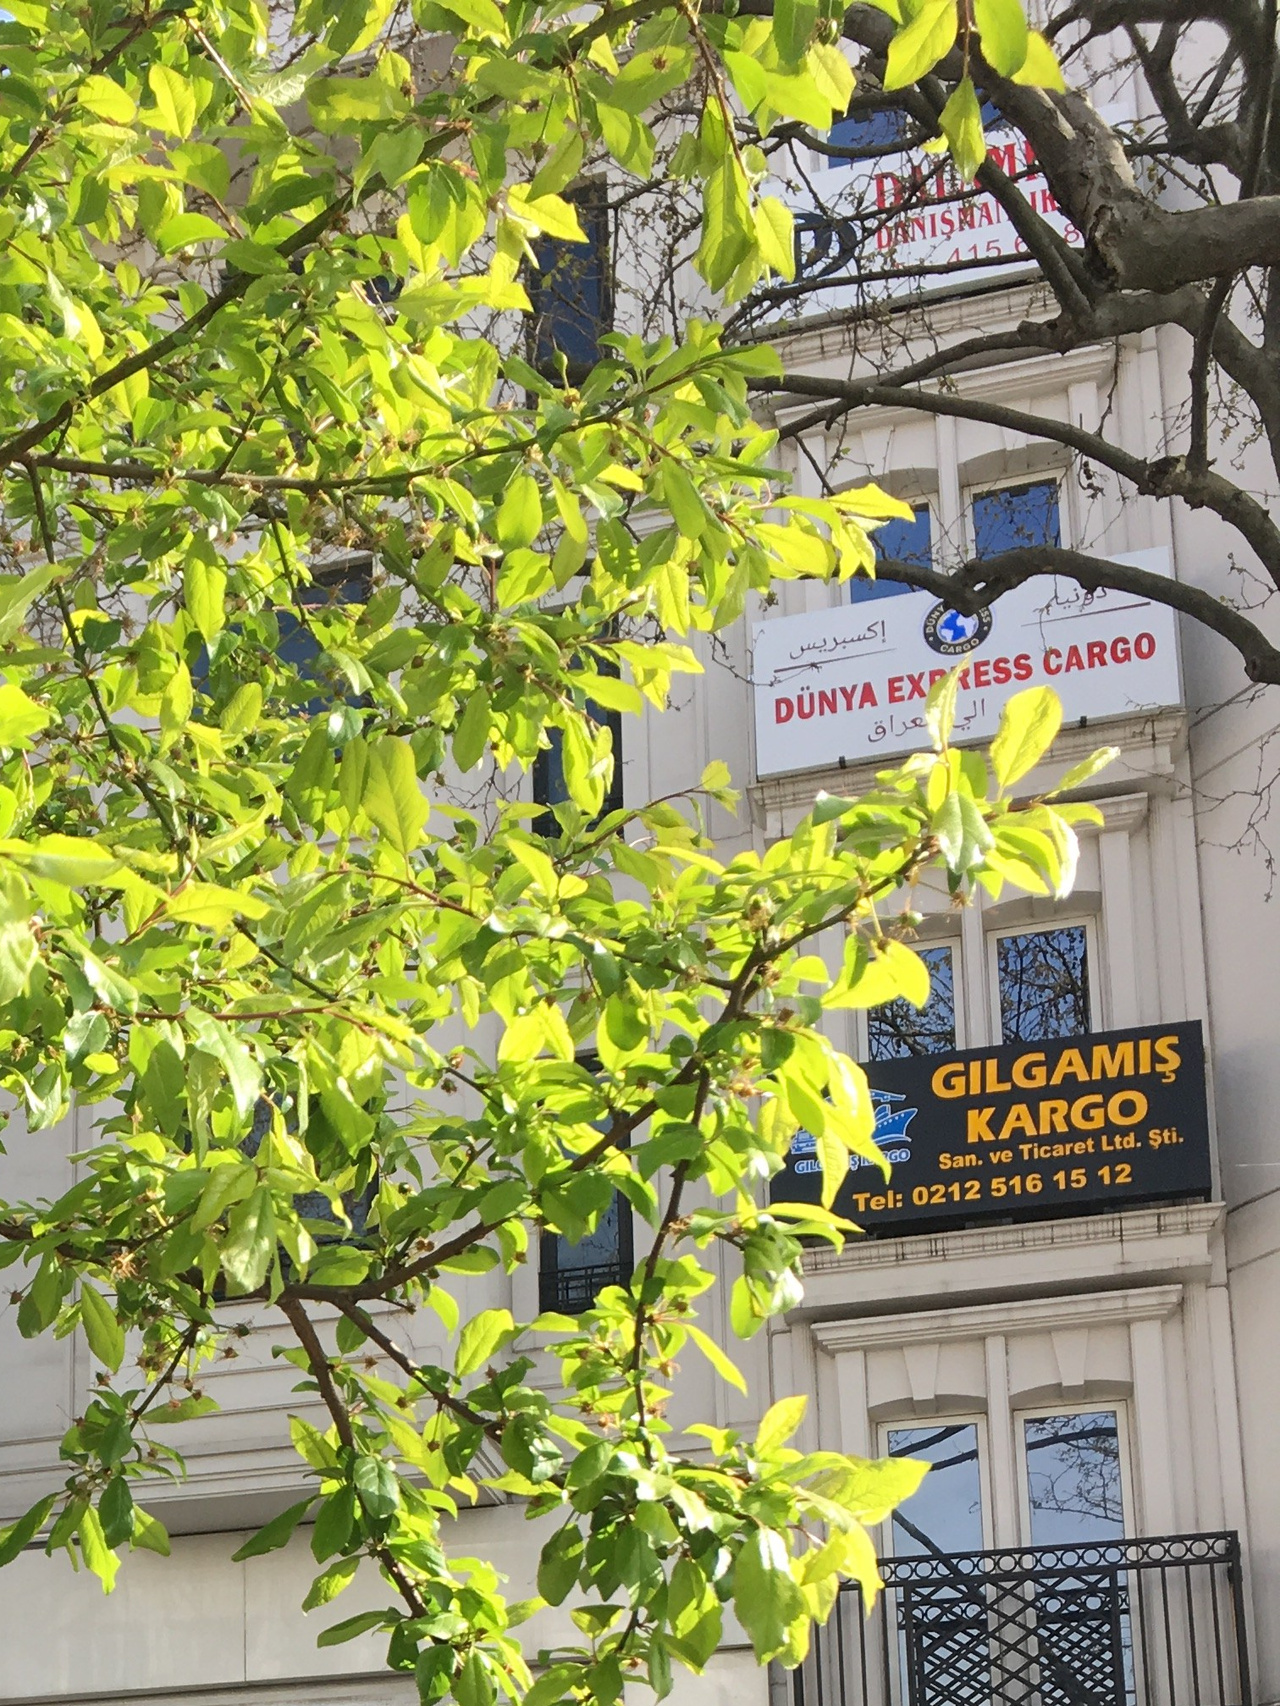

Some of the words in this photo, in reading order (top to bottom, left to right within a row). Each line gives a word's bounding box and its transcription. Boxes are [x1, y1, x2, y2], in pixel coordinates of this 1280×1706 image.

[940, 638, 980, 653] CARGO
[775, 681, 879, 724] DÜNYA
[1043, 632, 1156, 676] CARGO
[931, 1035, 1182, 1099] GILGAMIŞ
[967, 1090, 1149, 1144] KARGO
[938, 1152, 983, 1170] San.
[989, 1149, 1013, 1165] ve
[1019, 1137, 1095, 1161] Ticaret
[1101, 1131, 1142, 1152] Ltd.
[1148, 1127, 1185, 1150] Şti.
[852, 1189, 903, 1212] Tel:
[912, 1180, 981, 1206] 0212
[990, 1173, 1043, 1197] 516
[1052, 1167, 1088, 1190] 15
[1097, 1163, 1132, 1185] 12
